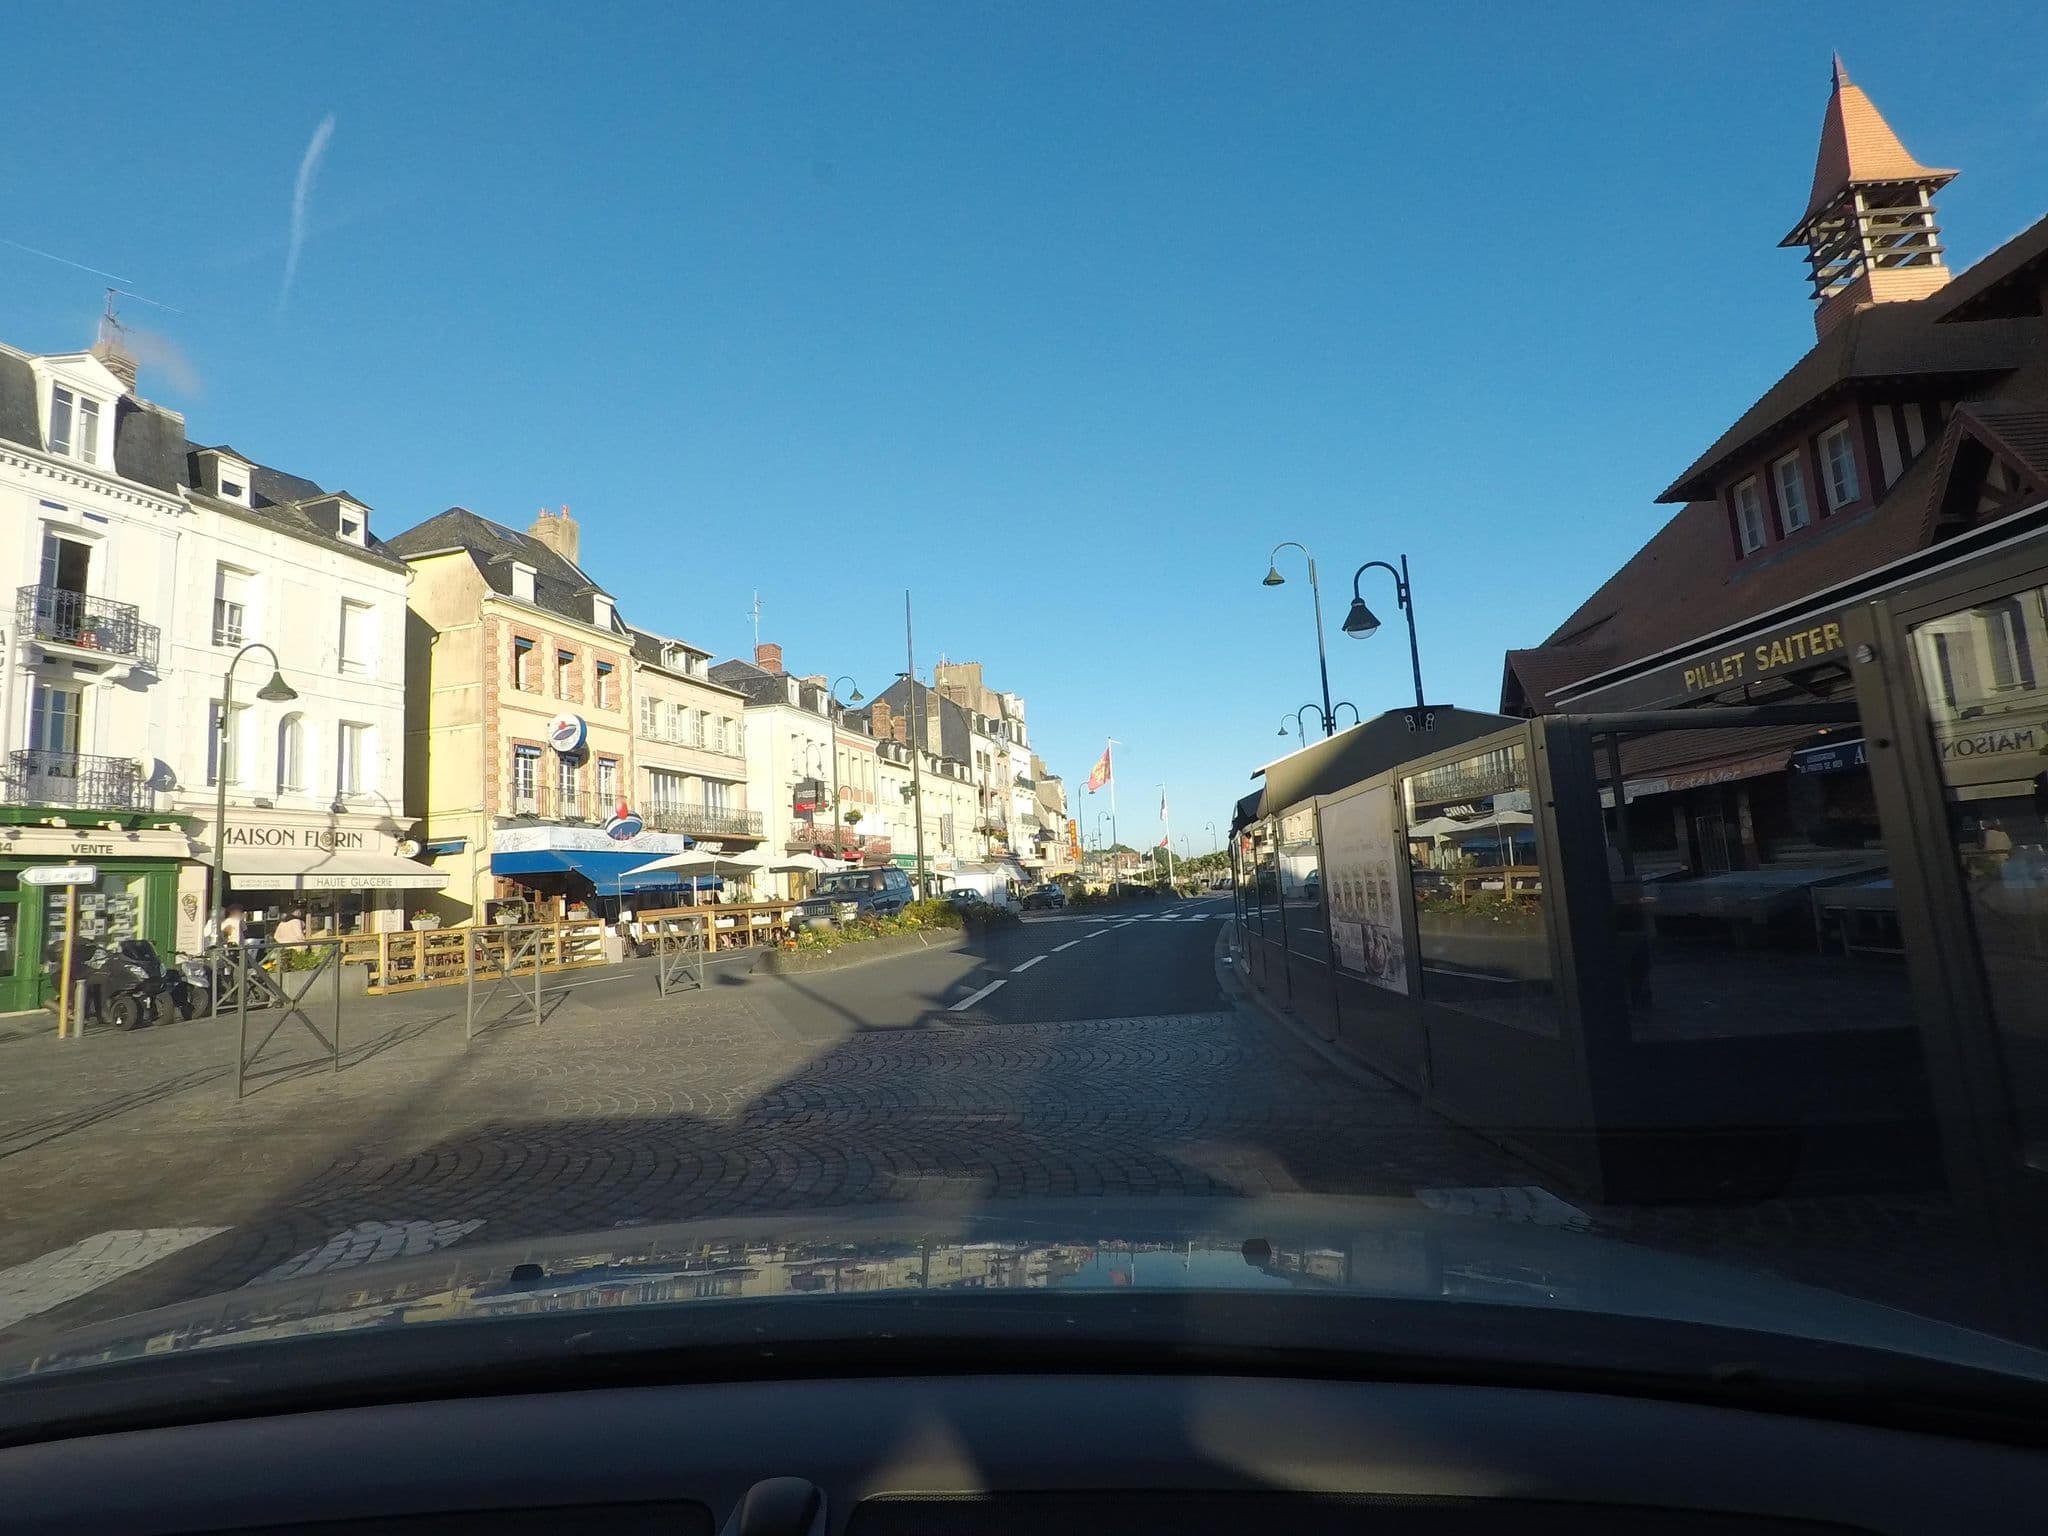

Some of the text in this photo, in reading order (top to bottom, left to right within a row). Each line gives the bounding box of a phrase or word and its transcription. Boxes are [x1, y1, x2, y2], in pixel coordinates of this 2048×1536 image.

[1684, 622, 1844, 692] PILLET SAITER
[71, 843, 114, 855] VENTE
[304, 830, 363, 852] FLORIN
[316, 877, 393, 888] HAUTE GLACERIE
